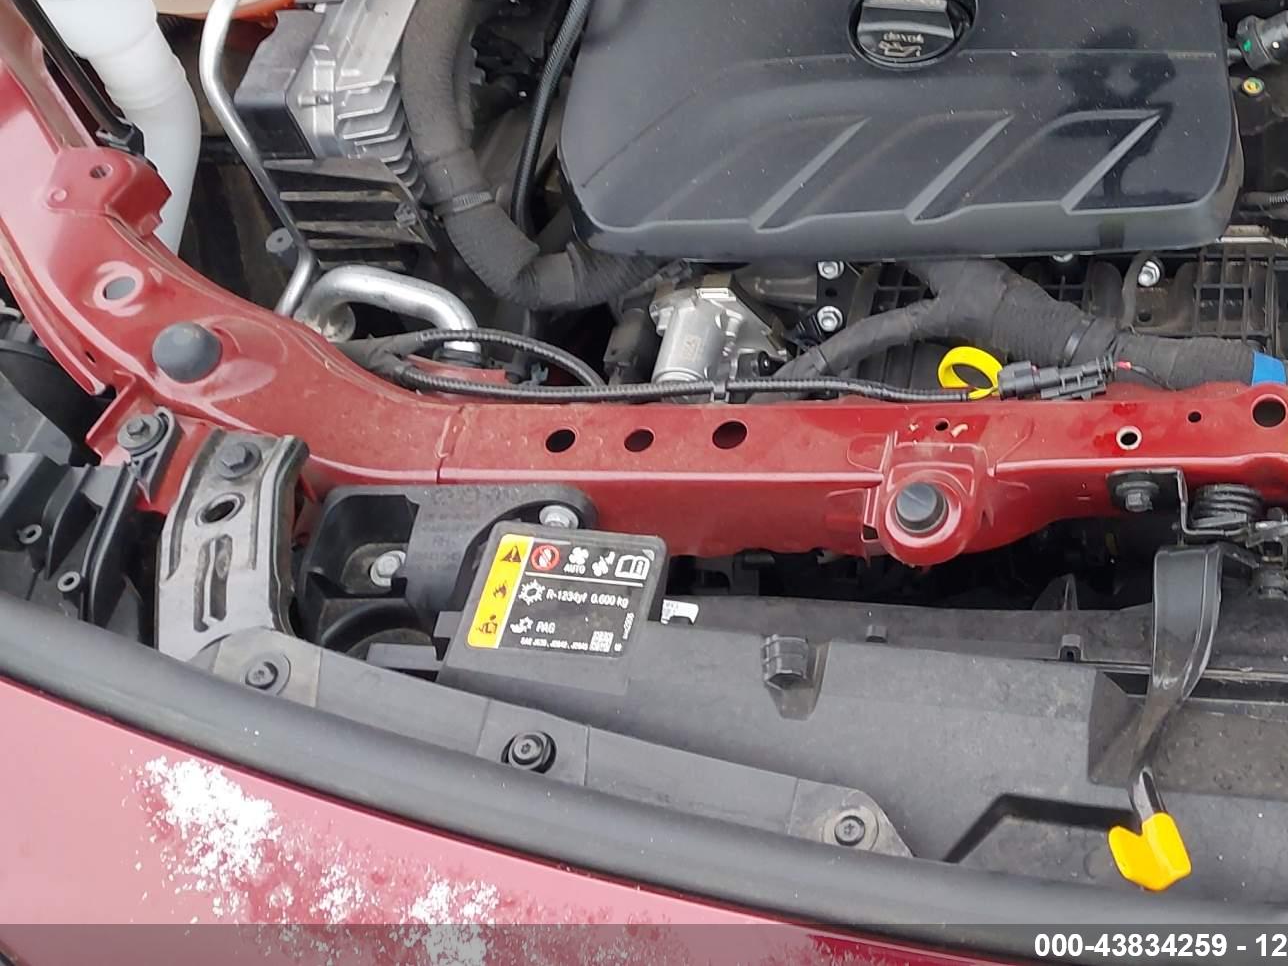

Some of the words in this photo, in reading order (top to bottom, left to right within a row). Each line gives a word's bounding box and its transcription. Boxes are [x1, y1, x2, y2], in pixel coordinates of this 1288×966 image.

[563, 563, 586, 575] AUTO
[546, 588, 588, 604] R-1234yf
[617, 596, 629, 609] kg
[535, 620, 556, 634] PAG
